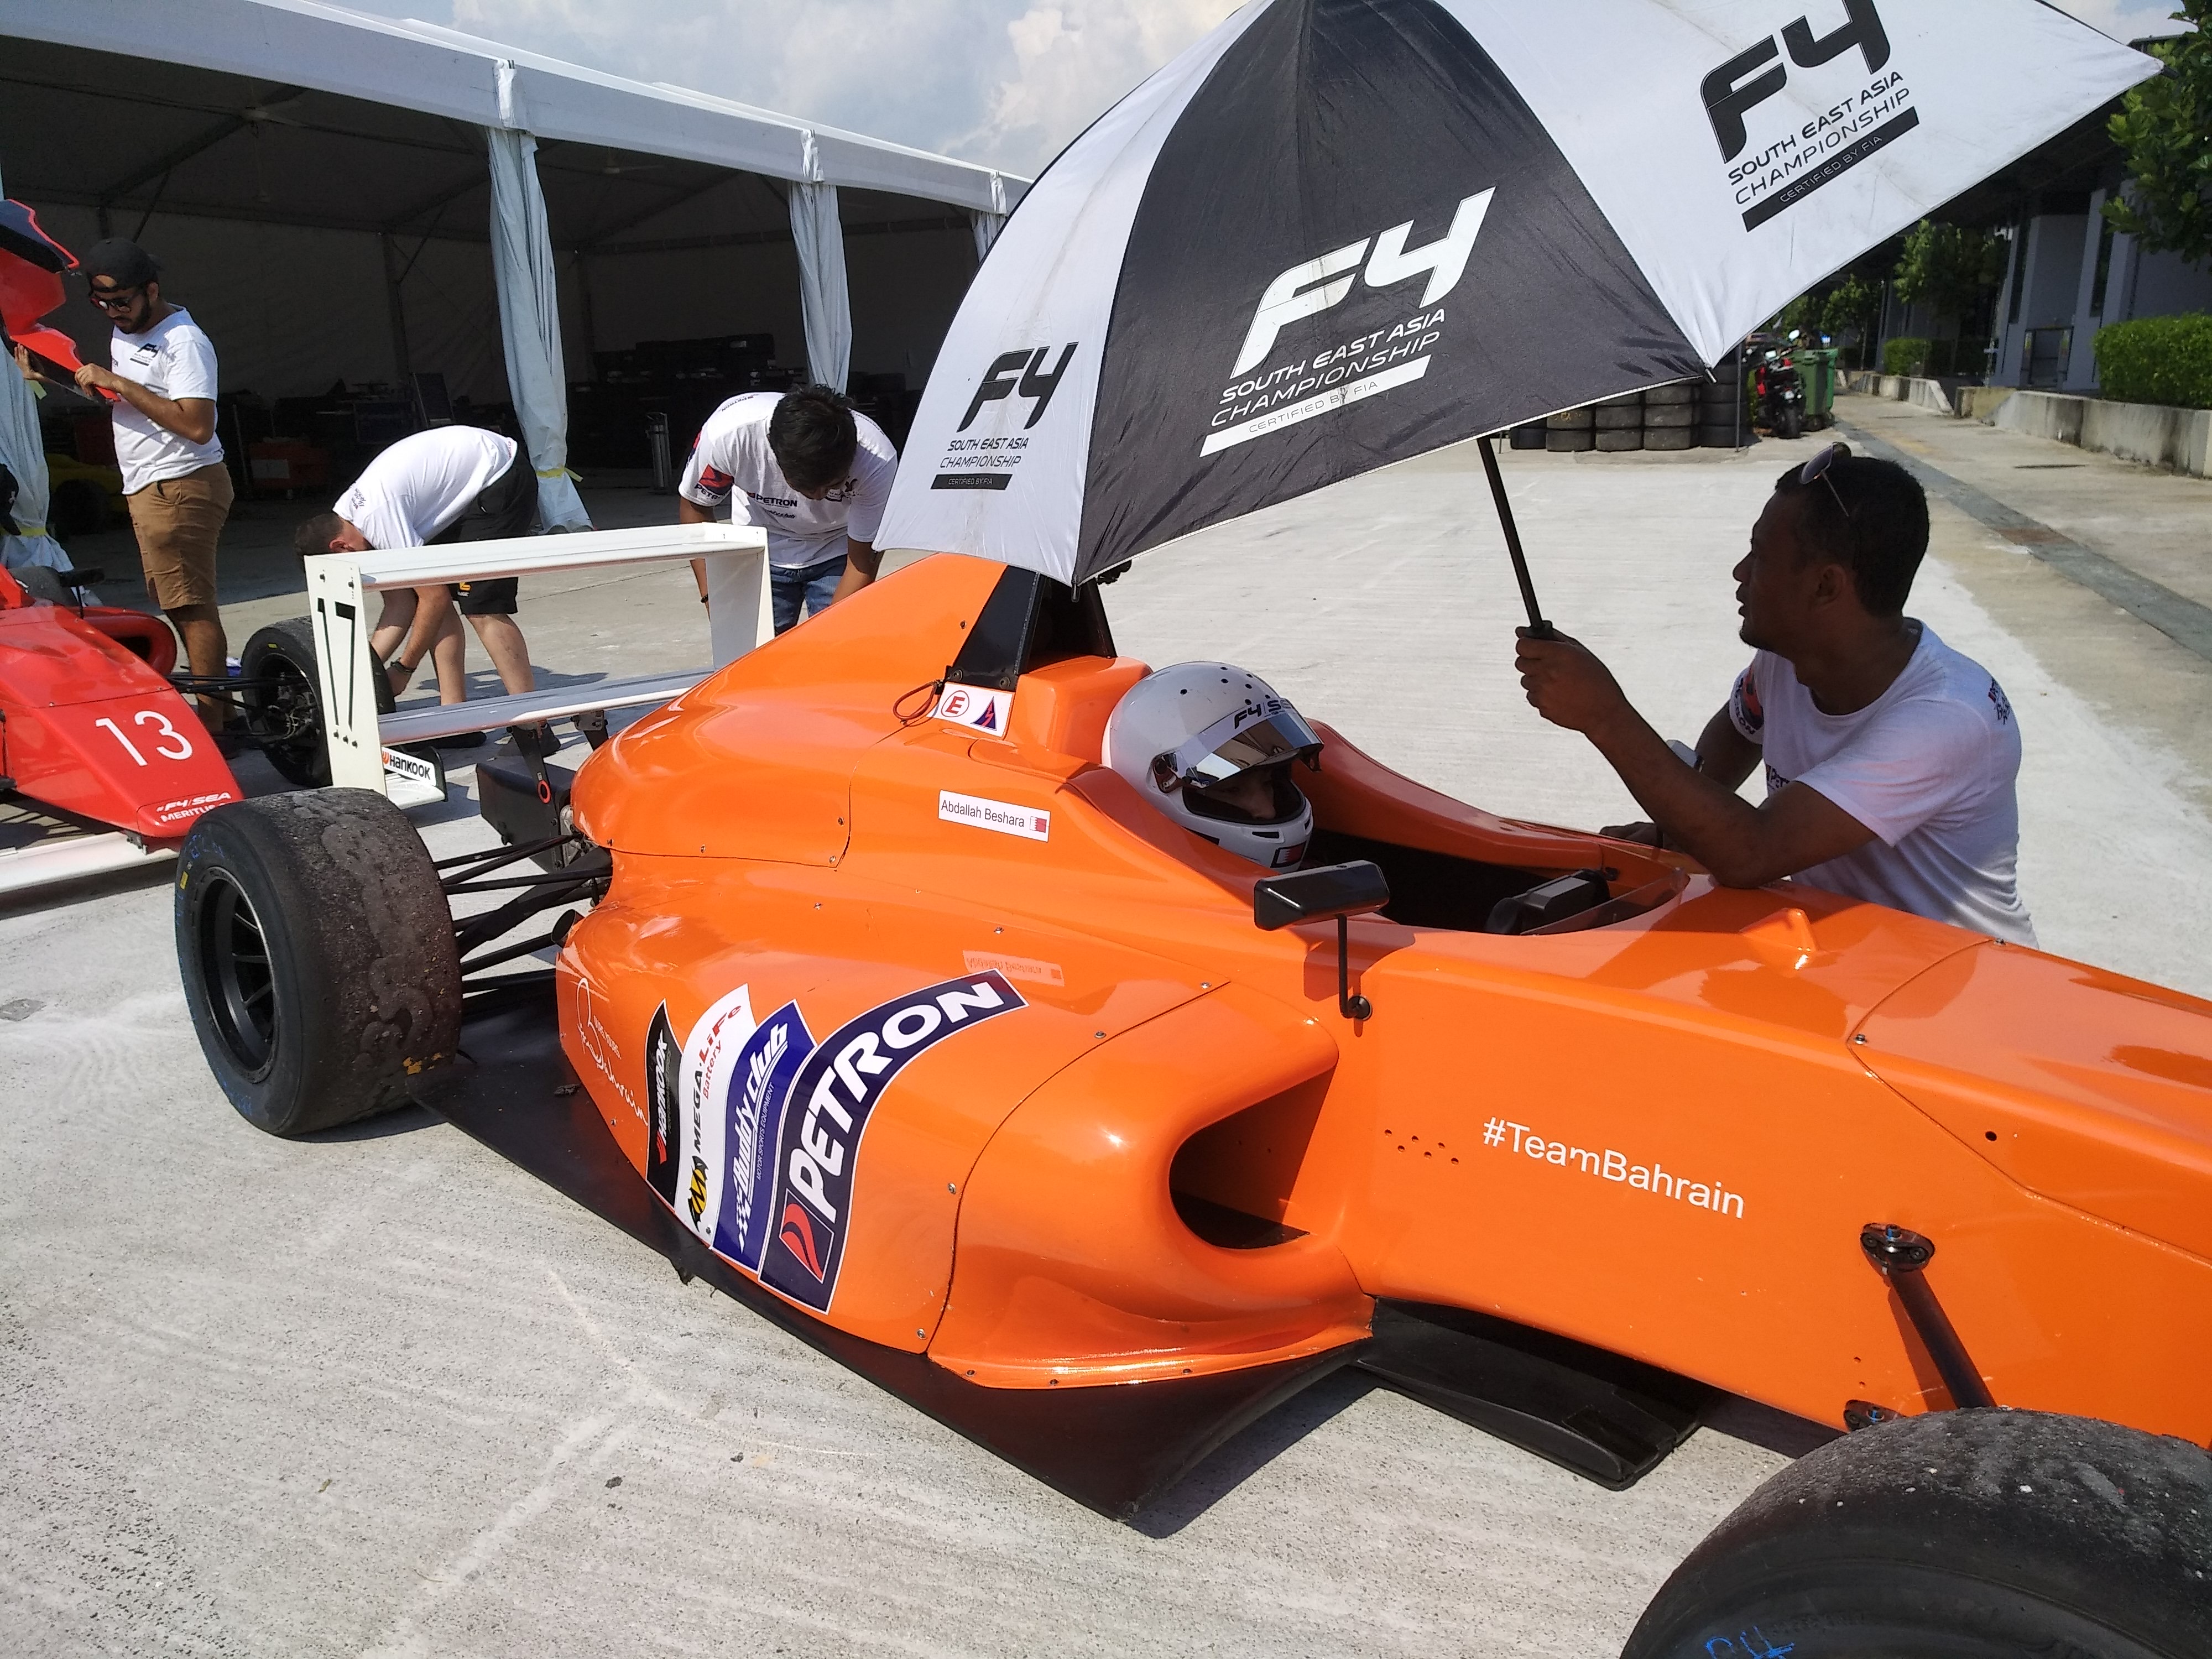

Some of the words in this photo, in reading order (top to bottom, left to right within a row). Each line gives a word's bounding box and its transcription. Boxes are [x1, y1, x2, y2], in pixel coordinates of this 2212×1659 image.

[1701, 0, 1891, 164] F4
[1728, 134, 1797, 186] SOUTH
[1802, 98, 1853, 139] EAST
[1861, 71, 1903, 105] ASIA
[1736, 88, 1910, 205] CHAMPIONSHIP
[1780, 161, 1841, 202] CERTIFIED
[1842, 148, 1859, 164] BY
[1861, 136, 1882, 152] FIA
[1229, 186, 1496, 380] F4
[956, 341, 1079, 432] F4
[1211, 331, 1440, 426] CHAMPIONSHIP
[1219, 360, 1306, 405] SOUTH
[1312, 330, 1385, 370] EAST
[1386, 308, 1445, 343] ASIA
[947, 439, 980, 451] SOUTH
[980, 437, 1008, 450] EAST
[1005, 437, 1029, 449] ASIA
[1249, 400, 1324, 433] CERTIFIED
[1331, 387, 1348, 404] BY
[1354, 382, 1378, 395] FIA
[756, 493, 797, 507] PETRON
[940, 455, 1021, 468] CHAMPIONSHIP
[317, 597, 356, 732] 17
[96, 710, 192, 766] 13
[1234, 703, 1262, 729] F4
[941, 800, 982, 818] Abdallah
[984, 808, 1025, 828] Beshara
[703, 1040, 721, 1100] Battery
[760, 1082, 775, 1129] EQUIPMENT
[789, 982, 1004, 1224] PETRON
[1483, 1117, 1744, 1219] #TeamBahrain
